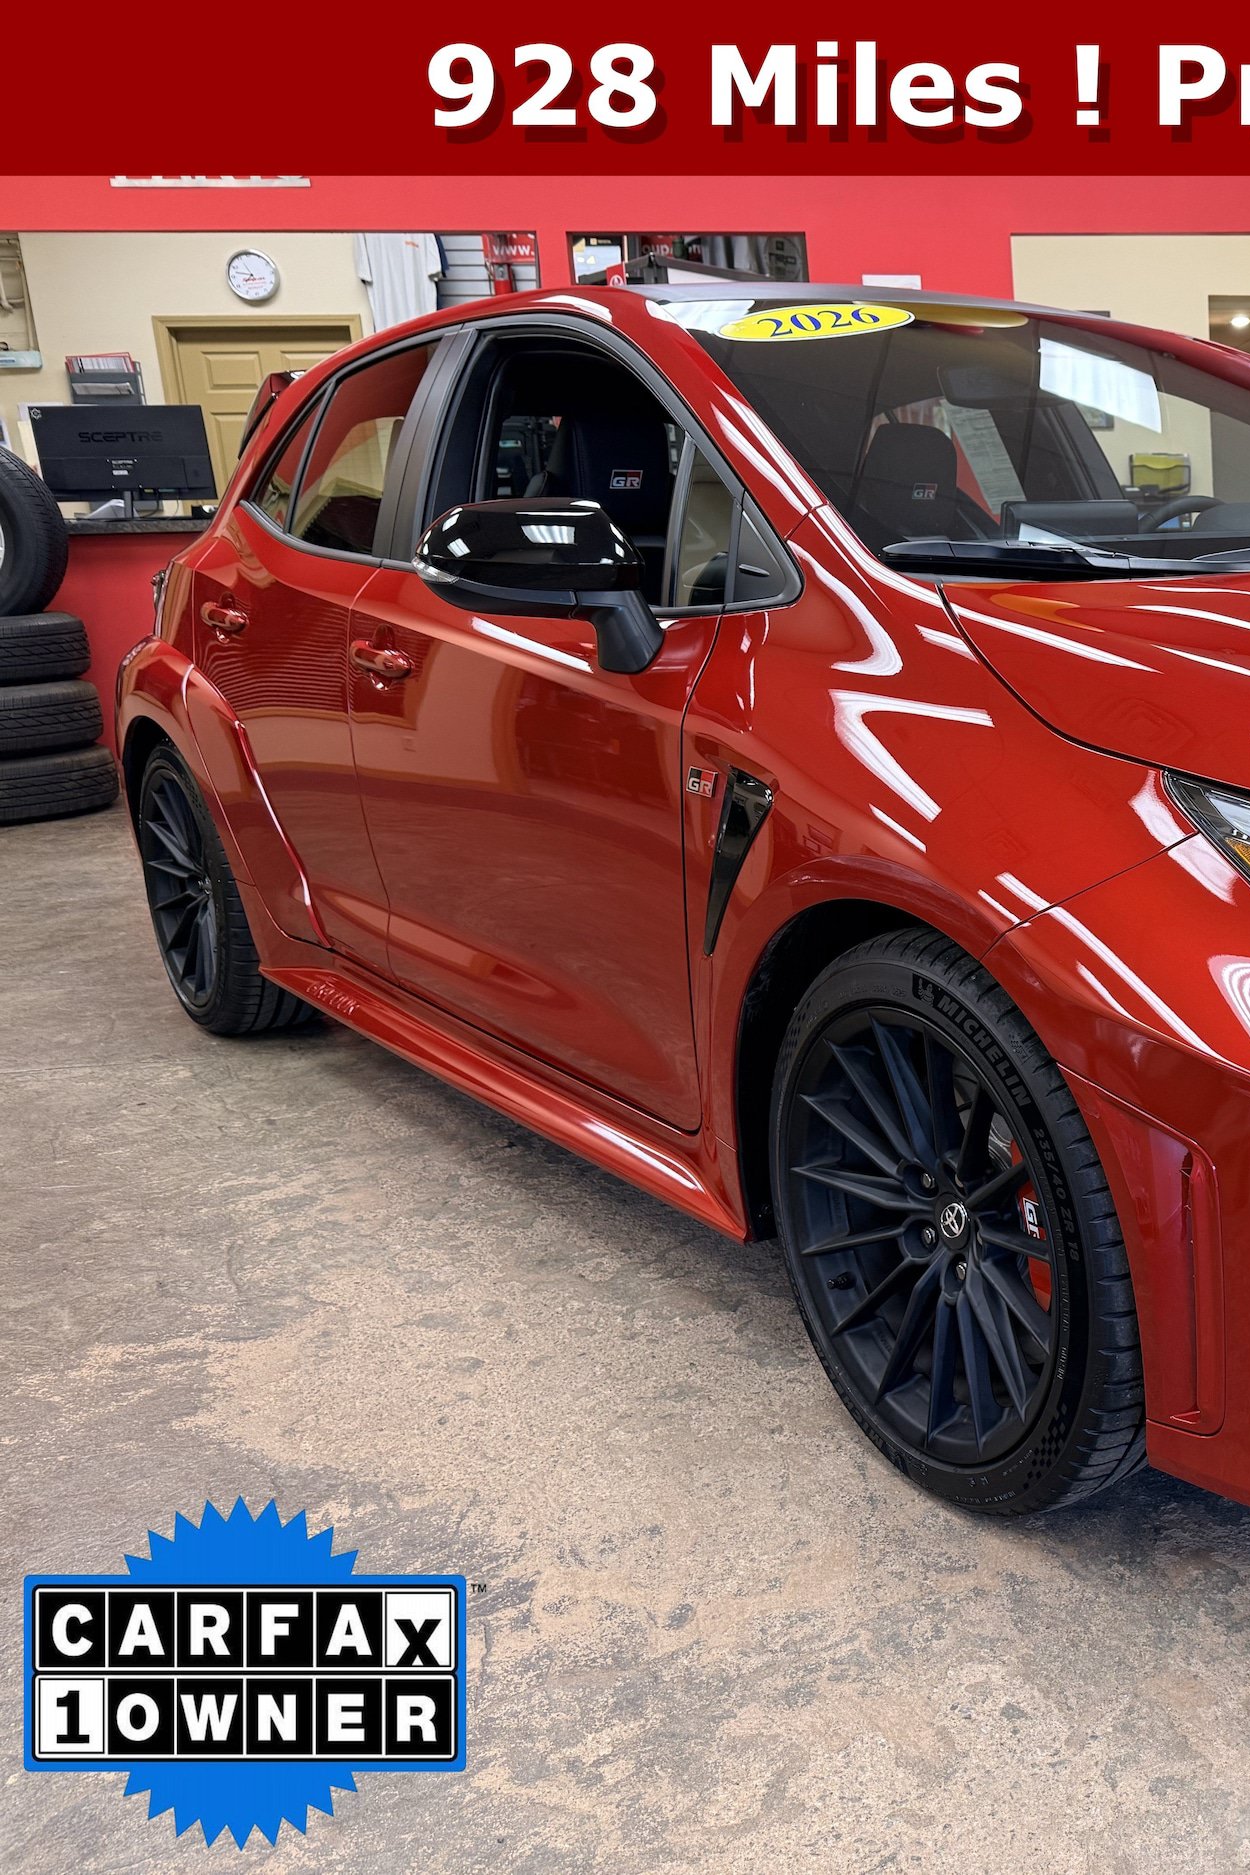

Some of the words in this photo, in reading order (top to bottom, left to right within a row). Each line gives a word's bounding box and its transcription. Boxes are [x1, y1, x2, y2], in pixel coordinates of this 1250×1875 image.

[757, 307, 880, 337] 2026
[78, 431, 163, 443] SCEPTRE
[937, 997, 1031, 1106] MICHELIN
[1033, 1128, 1066, 1199] 235/40
[1061, 1206, 1075, 1234] ZR
[1067, 1241, 1080, 1262] 18
